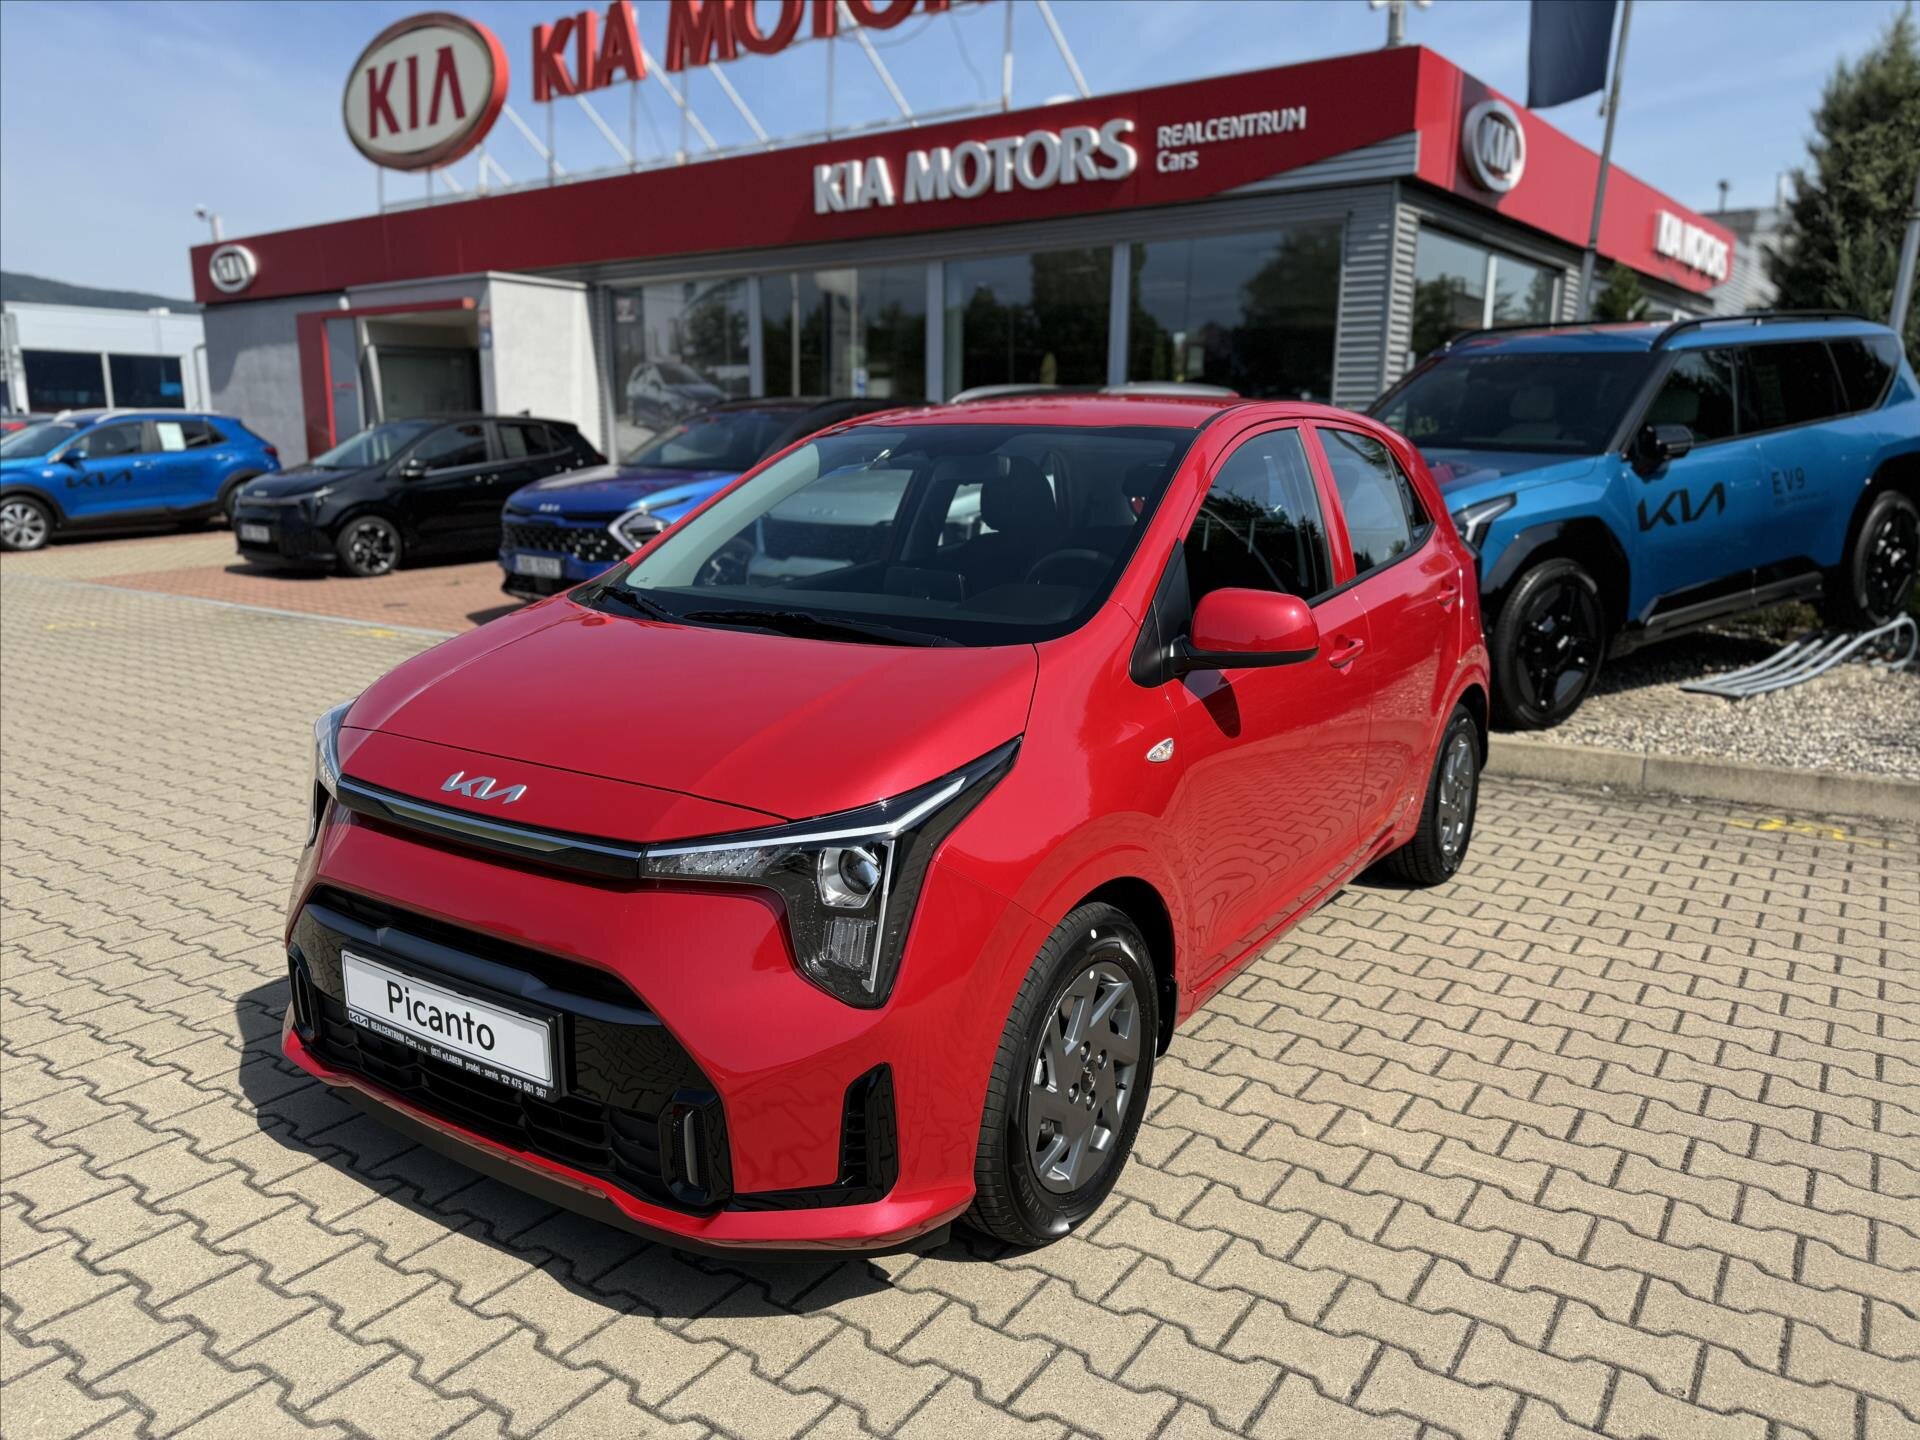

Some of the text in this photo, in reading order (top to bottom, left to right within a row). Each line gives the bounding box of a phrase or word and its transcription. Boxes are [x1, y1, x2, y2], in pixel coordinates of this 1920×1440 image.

[532, 0, 647, 102] KIA
[367, 45, 466, 139] KIA
[1157, 106, 1308, 149] REALCENTRUM
[813, 119, 1138, 213] KIA MOTORS
[1156, 151, 1199, 172] Cars
[1771, 466, 1806, 496] EV9
[1637, 481, 1726, 533] KIA
[440, 770, 527, 805] KIA
[349, 1011, 368, 1026] KIA
[386, 979, 496, 1051] Picanto
[405, 1036, 417, 1049] Cars
